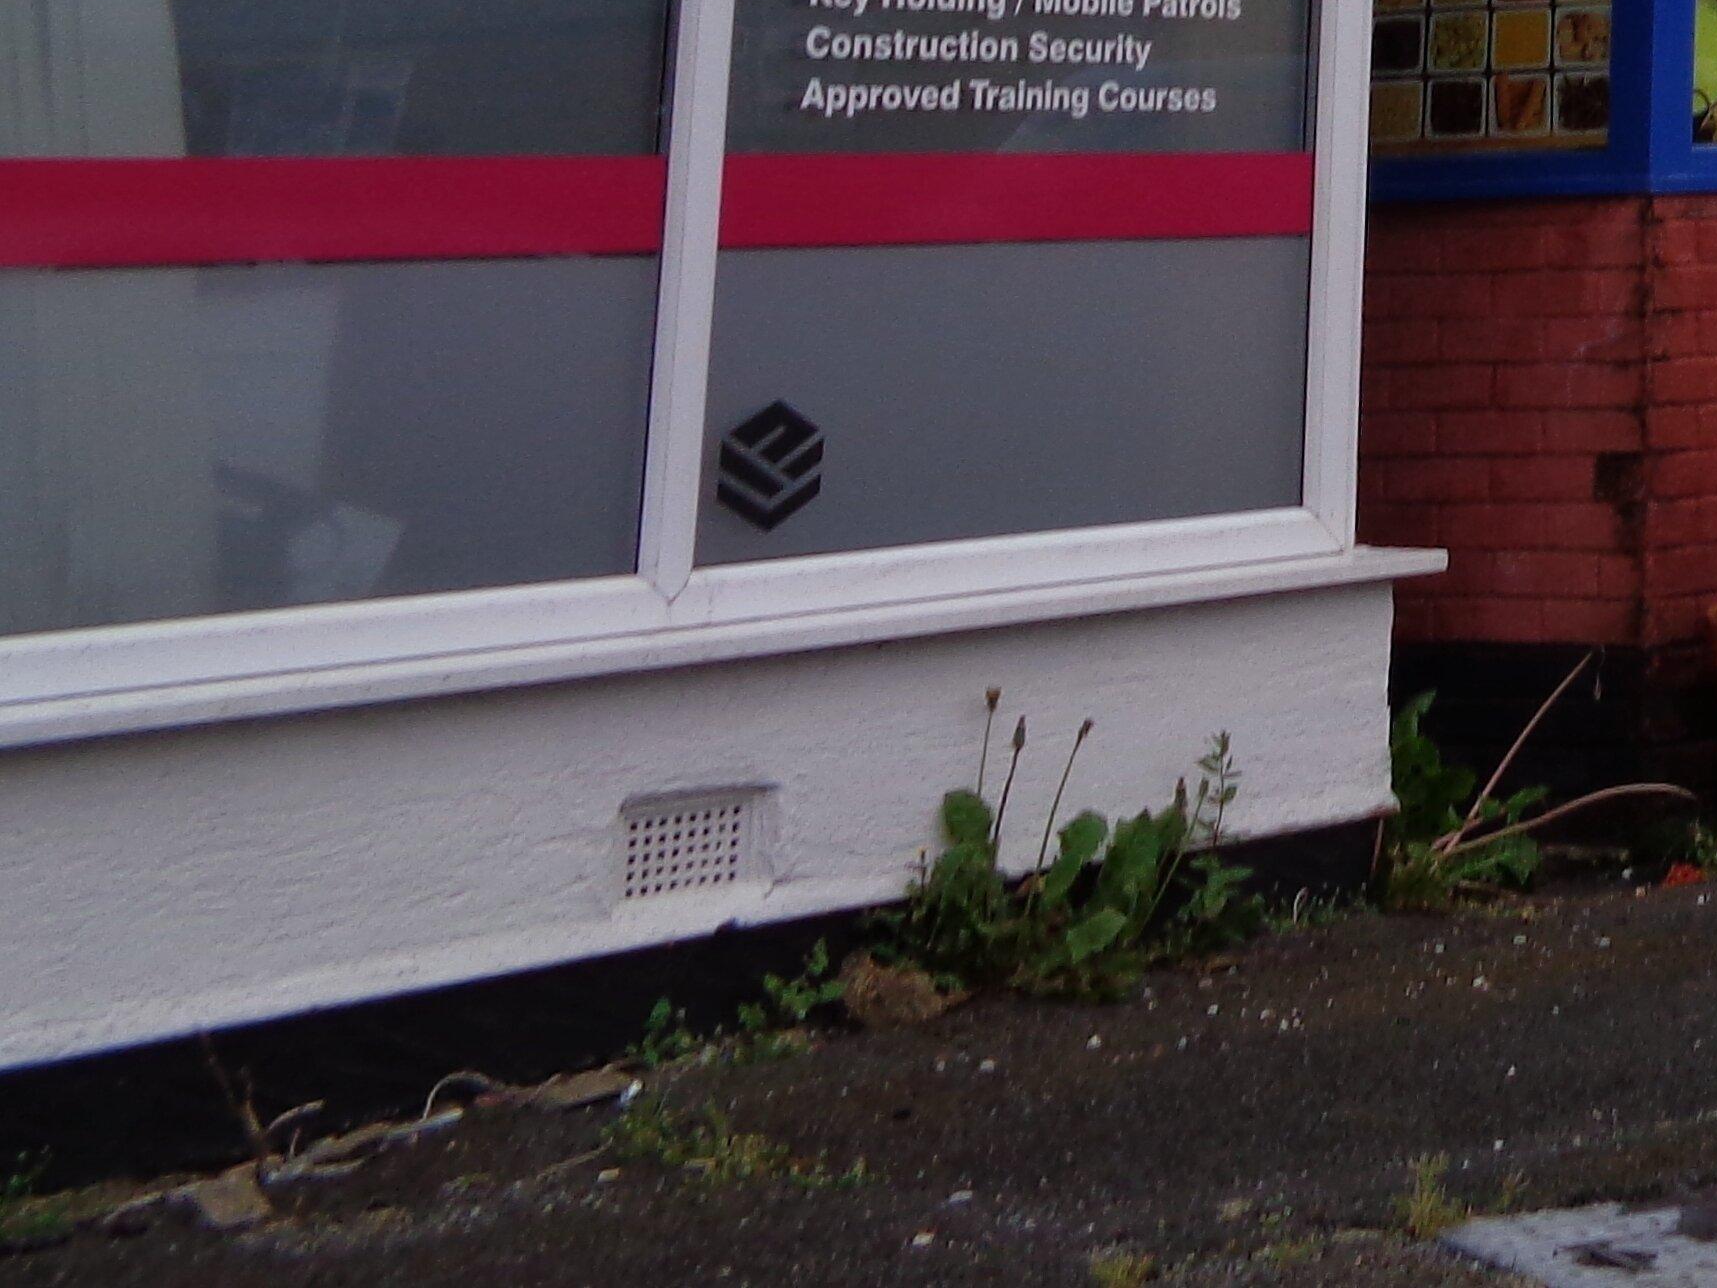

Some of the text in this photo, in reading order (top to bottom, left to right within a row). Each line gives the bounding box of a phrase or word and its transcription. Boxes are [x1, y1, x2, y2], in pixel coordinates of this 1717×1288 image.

[804, 25, 1153, 71] Construction Security
[800, 77, 1218, 119] Approved Training Courses
